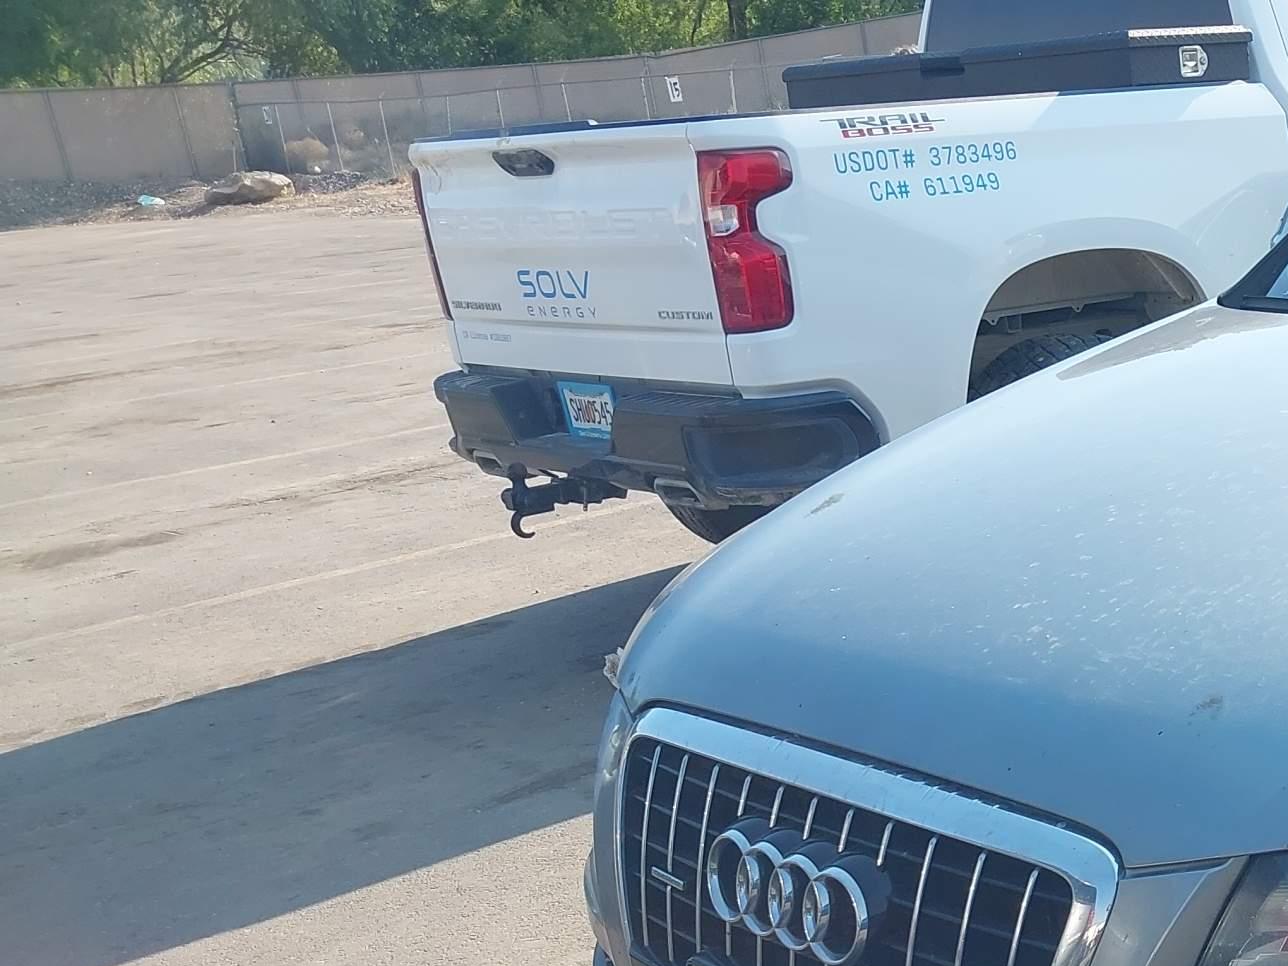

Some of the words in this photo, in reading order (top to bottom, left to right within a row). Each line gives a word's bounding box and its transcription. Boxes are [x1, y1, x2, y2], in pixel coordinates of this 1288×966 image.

[669, 80, 681, 99] 15
[819, 112, 945, 129] TRAIL
[841, 123, 935, 138] BOSS
[834, 148, 916, 174] USDOT#
[929, 141, 1017, 167] 3783496
[869, 179, 911, 202] CA#
[923, 172, 1000, 197] 611949
[517, 270, 591, 299] SOLV
[657, 310, 714, 321] CUSTOM
